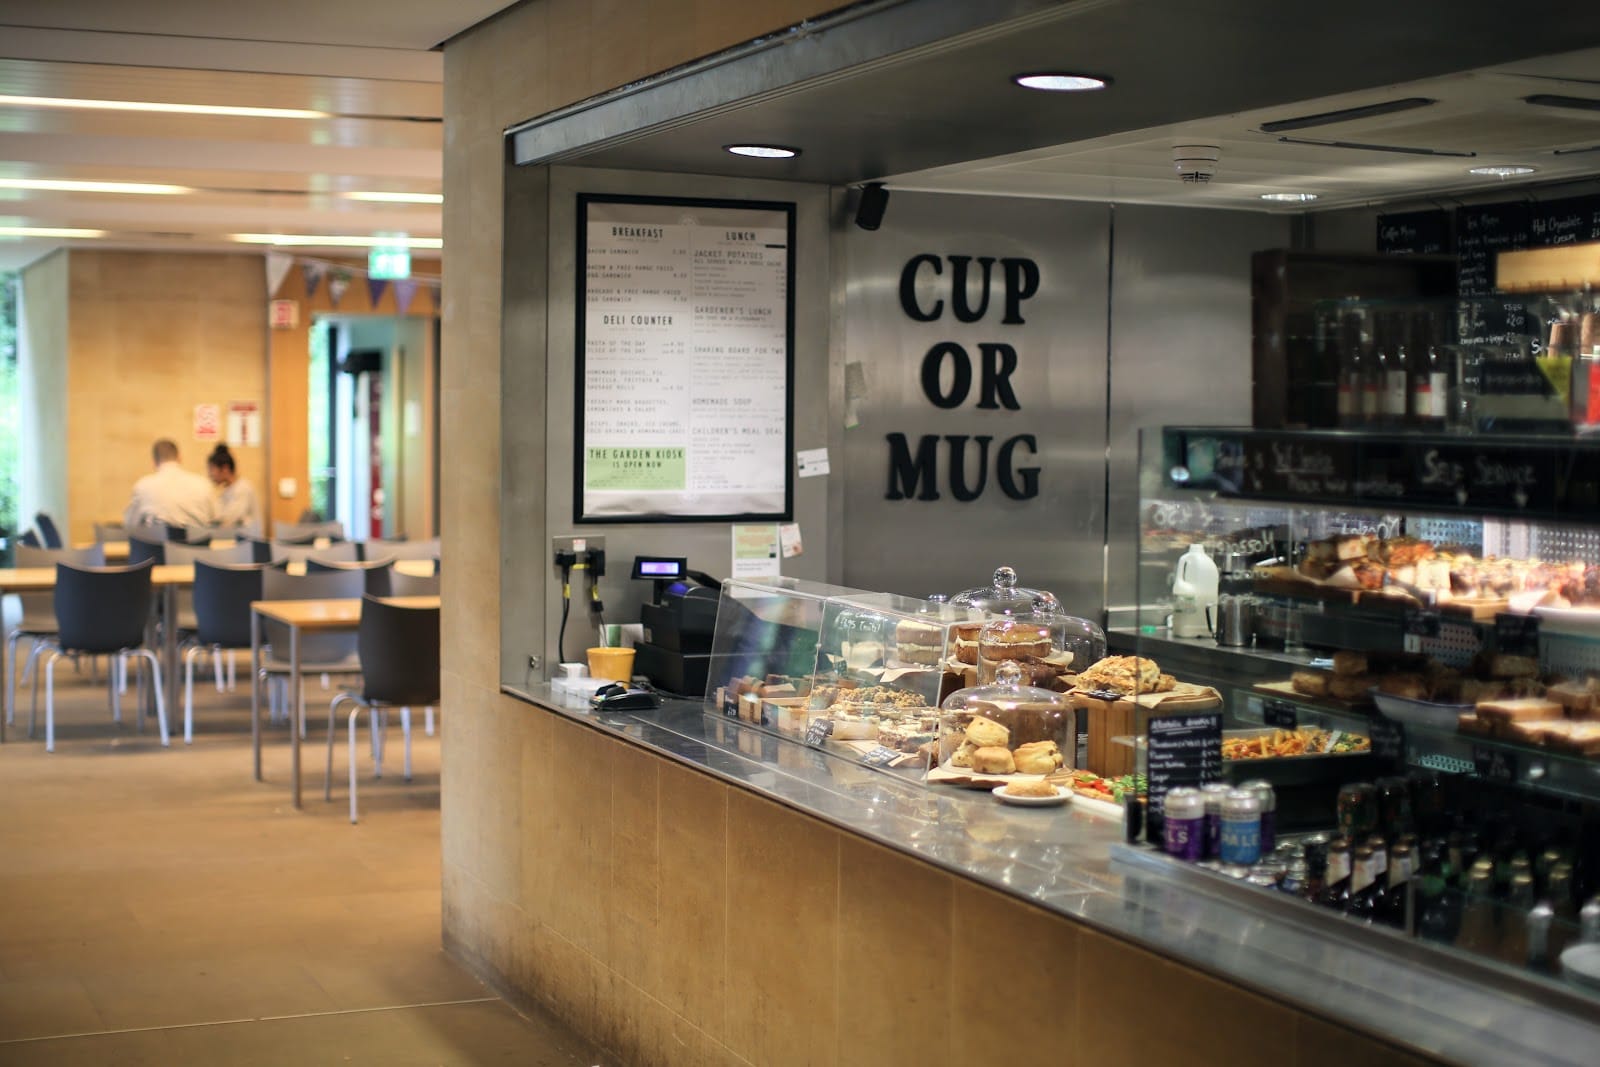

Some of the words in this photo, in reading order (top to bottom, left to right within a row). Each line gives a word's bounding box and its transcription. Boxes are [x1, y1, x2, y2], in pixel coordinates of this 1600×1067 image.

[612, 227, 664, 238] BREAKFAST
[726, 232, 756, 241] LUNCH
[694, 250, 723, 258] JACKET
[727, 251, 764, 260] POTATOES
[899, 254, 1041, 325] CUP
[694, 306, 746, 316] GARDENER'S
[748, 308, 773, 317] LUNCH
[603, 315, 626, 325] DELI
[630, 315, 673, 325] COUNTER
[694, 346, 725, 355] SHARING
[728, 347, 751, 355] BOARD
[921, 342, 1021, 411] OR
[692, 398, 729, 406] HOMEMADE
[733, 398, 753, 406] SOUP
[692, 427, 738, 436] CHILDREN'S
[741, 427, 762, 435] MEAL
[590, 449, 607, 459] THE
[613, 449, 651, 459] GARDEN
[655, 449, 684, 460] KIOSK
[623, 461, 643, 469] OPEN
[645, 461, 663, 469] NOW
[886, 432, 1041, 502] MUG
